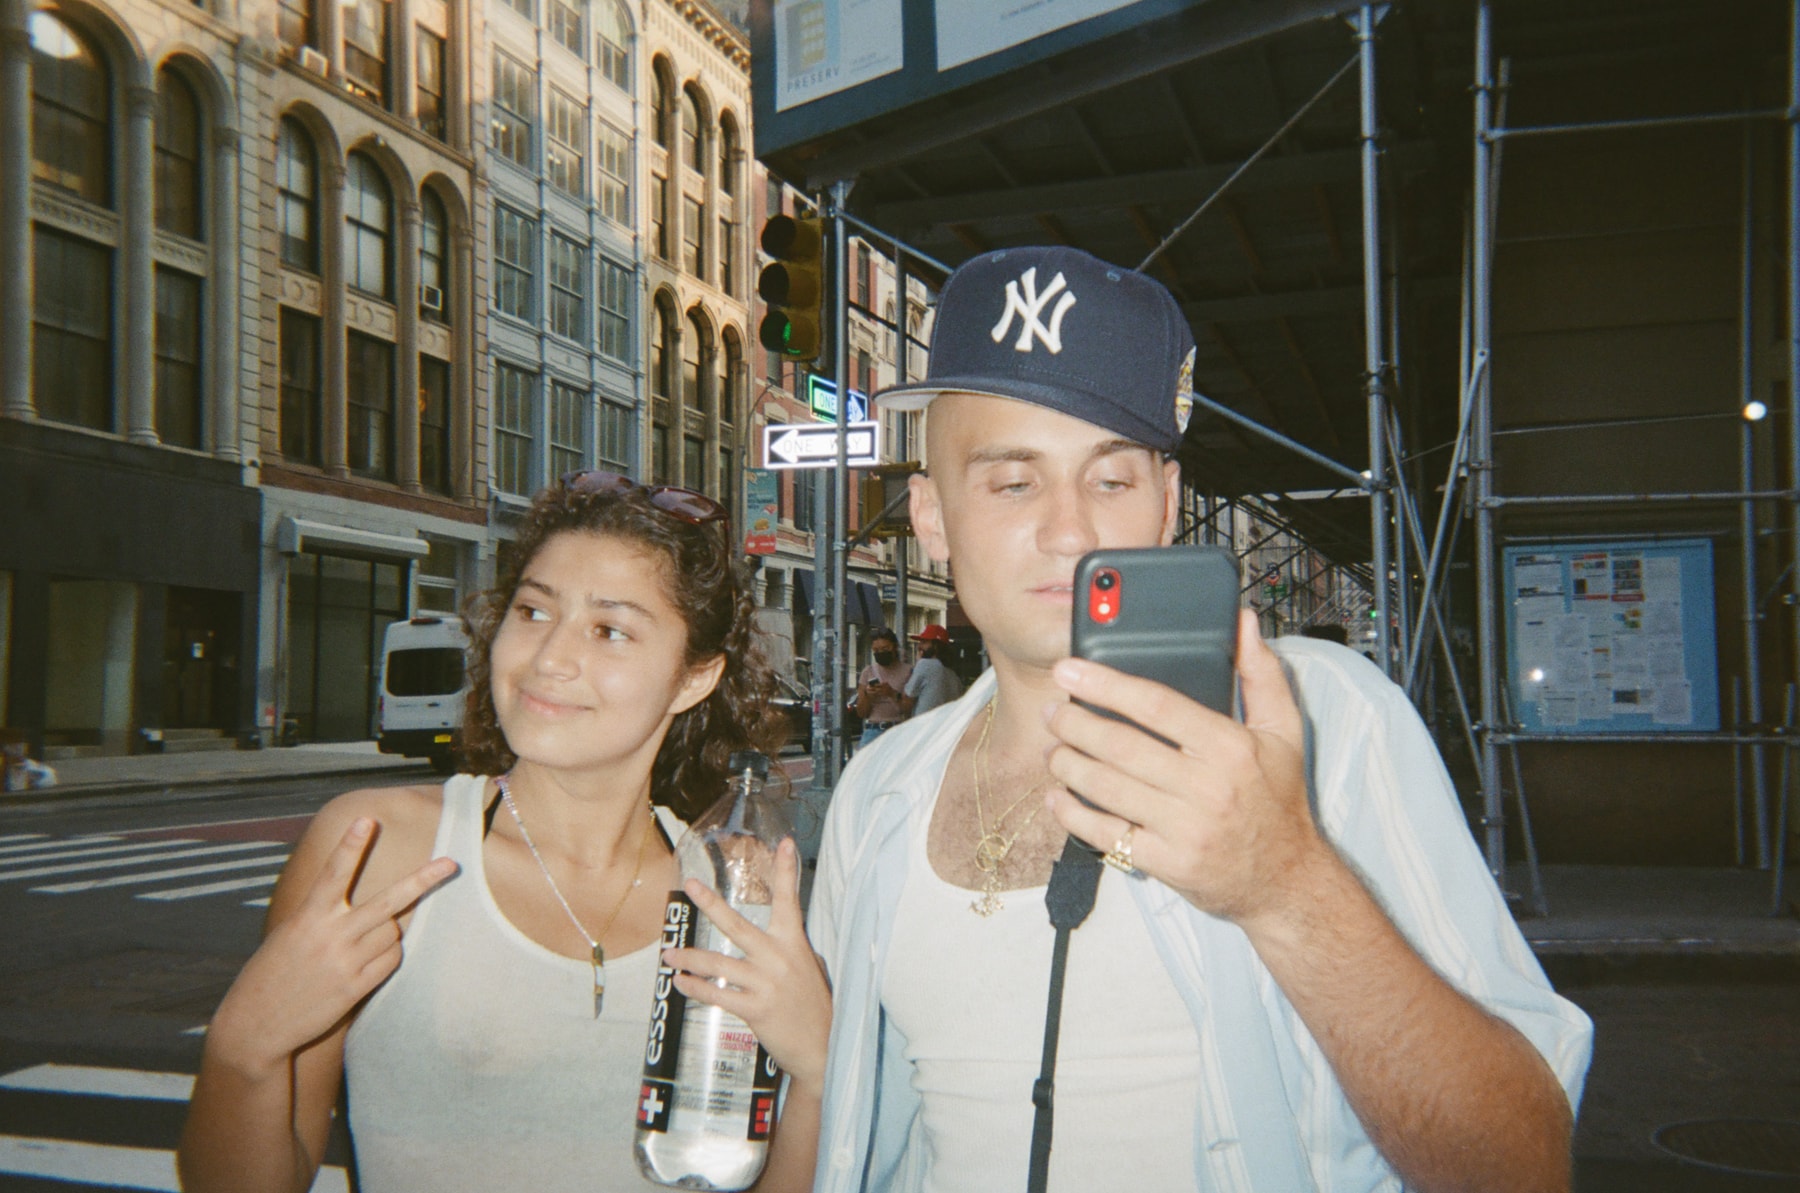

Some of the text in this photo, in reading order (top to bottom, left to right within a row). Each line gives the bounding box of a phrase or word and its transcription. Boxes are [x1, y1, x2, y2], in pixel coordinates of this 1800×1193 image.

[787, 66, 840, 92] PRESERV
[991, 266, 1077, 355] NY
[820, 393, 836, 411] ONE
[783, 436, 862, 454] ONE WY
